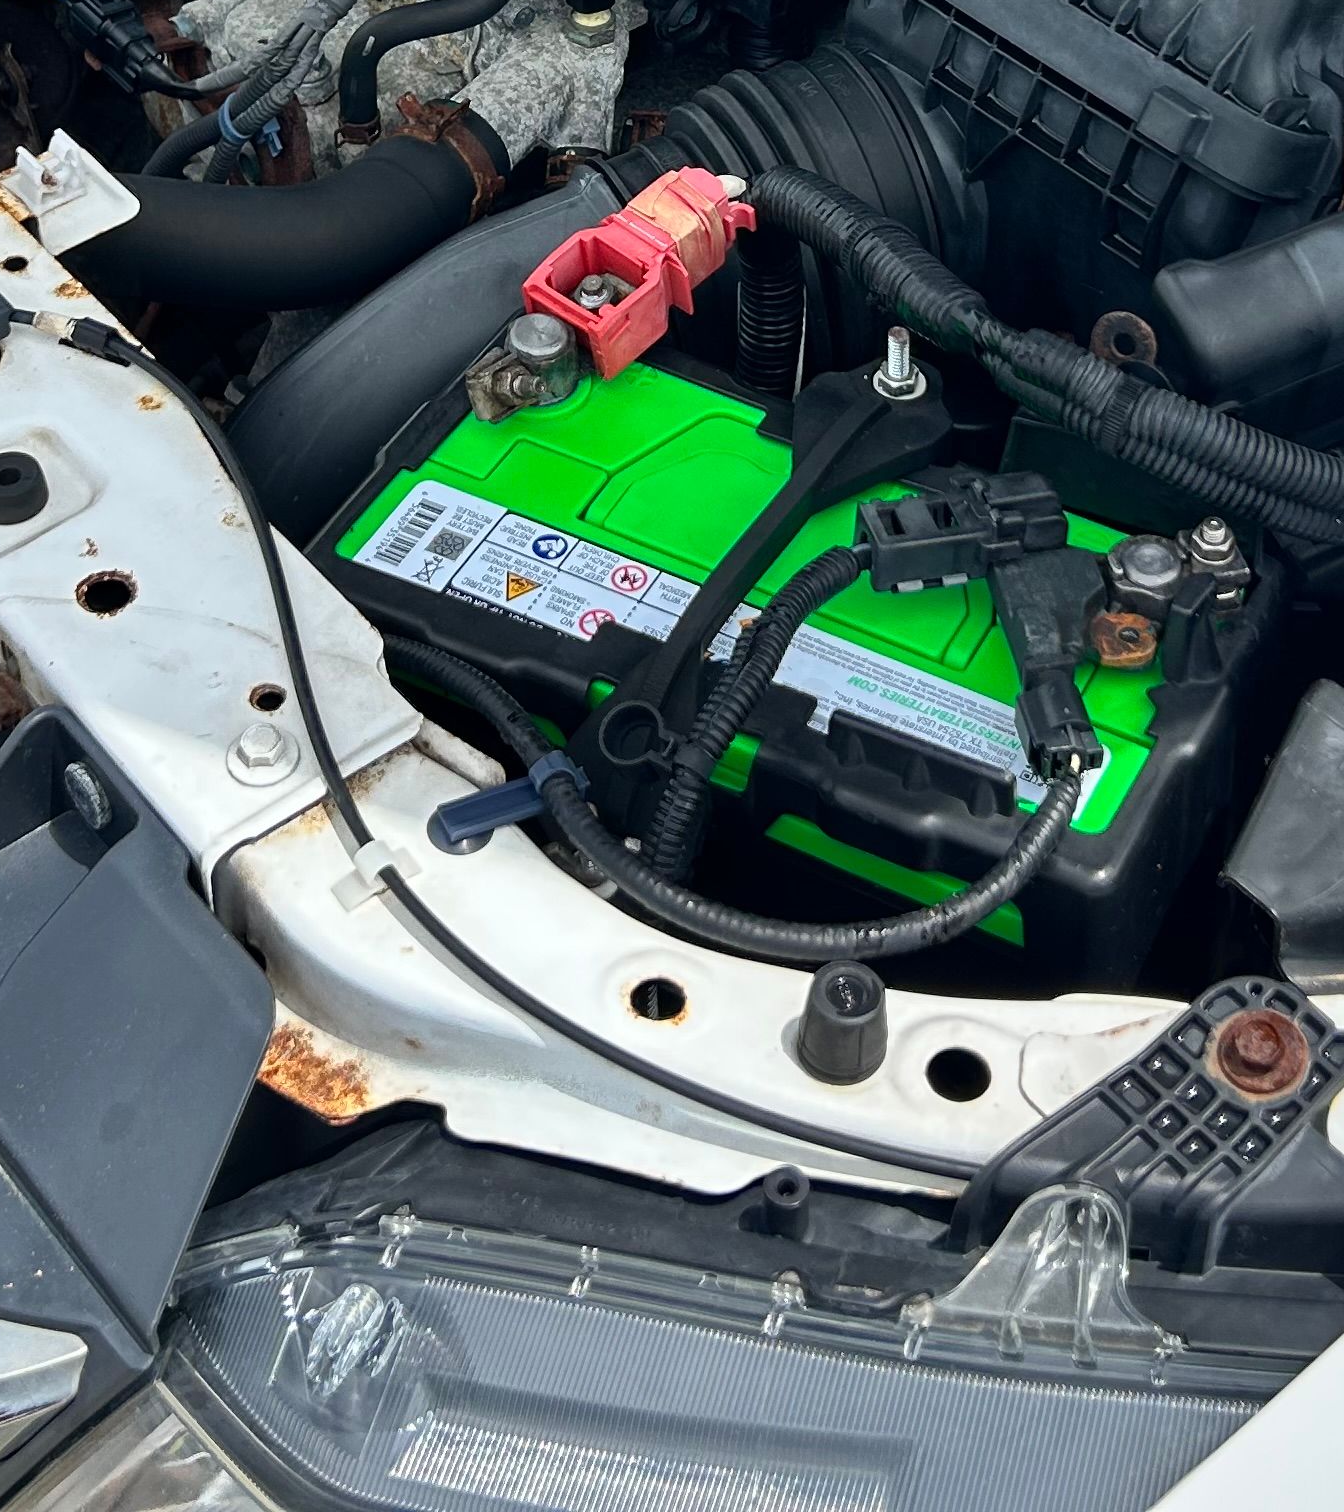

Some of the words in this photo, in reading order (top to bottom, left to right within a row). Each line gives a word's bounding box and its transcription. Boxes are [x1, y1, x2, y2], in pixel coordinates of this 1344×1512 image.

[452, 513, 463, 521] BE
[462, 517, 484, 530] MUST
[446, 520, 479, 536] BATTERY
[507, 536, 527, 548] READ
[480, 554, 522, 573] BLINDNESS
[514, 558, 540, 572] SEVERE
[568, 565, 582, 574] OUT
[583, 562, 597, 572] THE
[588, 556, 614, 570] REACH
[487, 565, 505, 576] CAN
[520, 568, 548, 583] CAUSE
[540, 569, 553, 577] OR
[581, 569, 605, 582] KEEP
[482, 574, 502, 586] ACID
[462, 577, 503, 598] SULFURIC
[550, 586, 586, 604] SMOKING
[550, 594, 582, 610] FLAMES
[546, 602, 576, 617] SPARKS
[560, 617, 575, 628] NO
[847, 674, 1023, 753] INTERSTATEBATTERIES.COM
[856, 699, 898, 723] Batteries,
[917, 715, 936, 728] USA
[900, 718, 946, 742] Interstate
[938, 724, 968, 741] 75254
[946, 734, 960, 747] by
[969, 736, 982, 748] TX
[959, 738, 1014, 772] Distributed
[987, 741, 1018, 762] Dallas,
